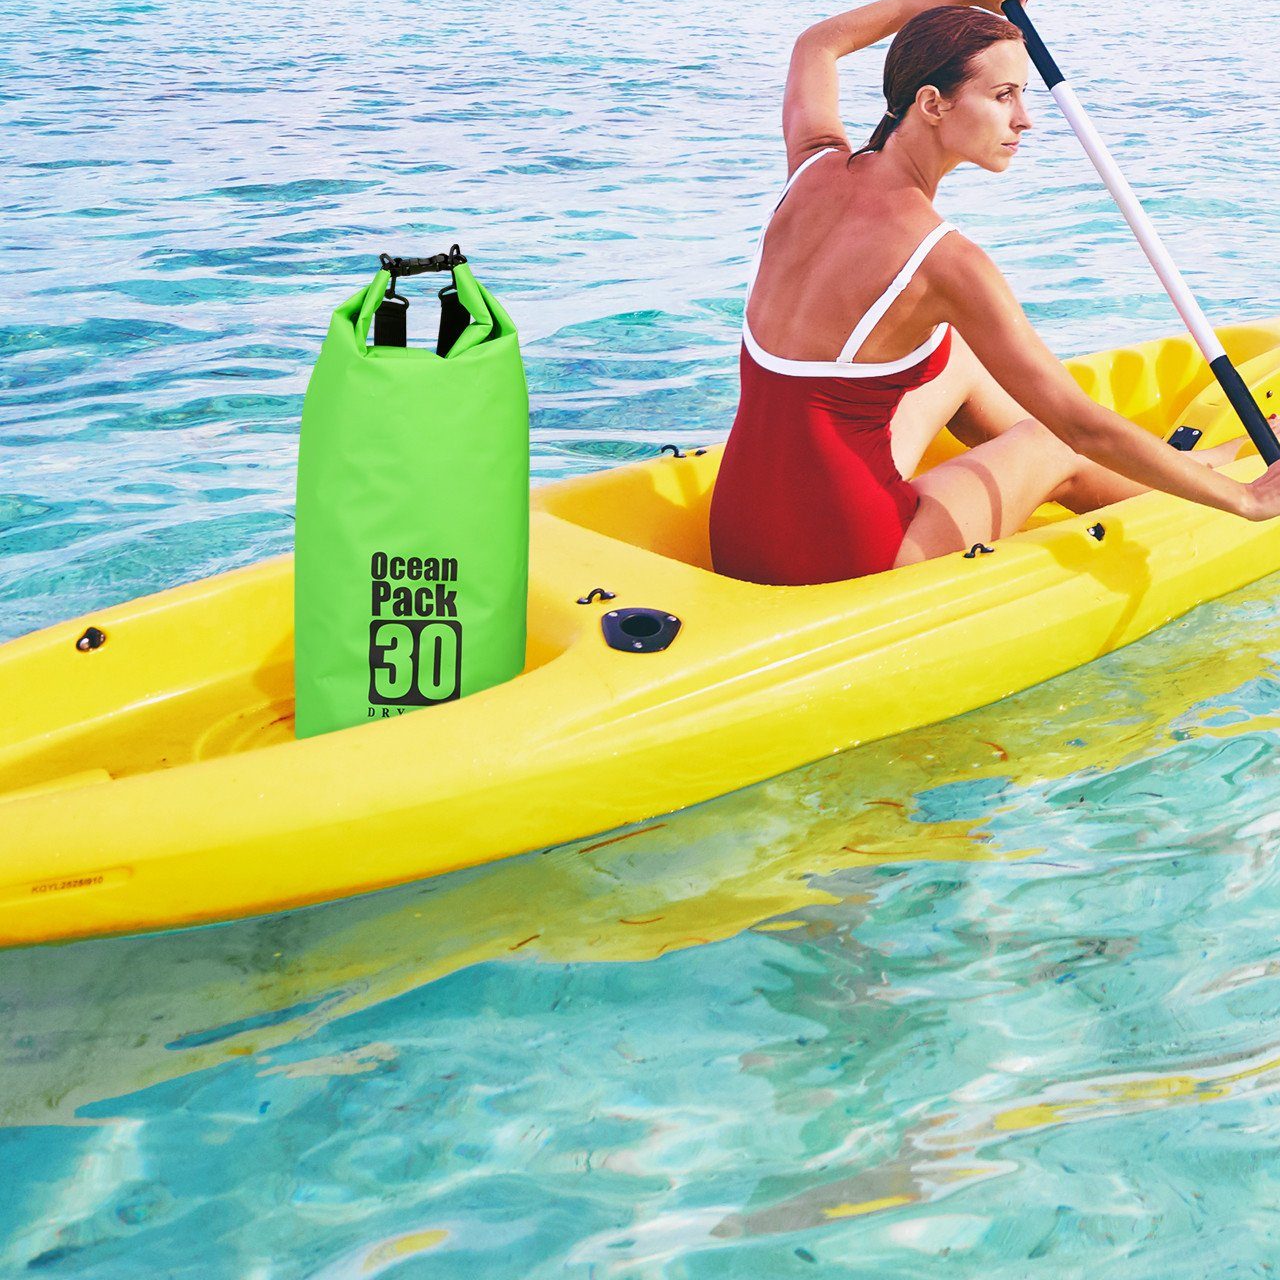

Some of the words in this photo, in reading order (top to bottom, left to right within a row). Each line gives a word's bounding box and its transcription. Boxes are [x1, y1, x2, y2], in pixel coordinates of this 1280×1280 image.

[371, 551, 458, 582] Ocean
[371, 581, 458, 617] Pack
[374, 623, 457, 700] 30
